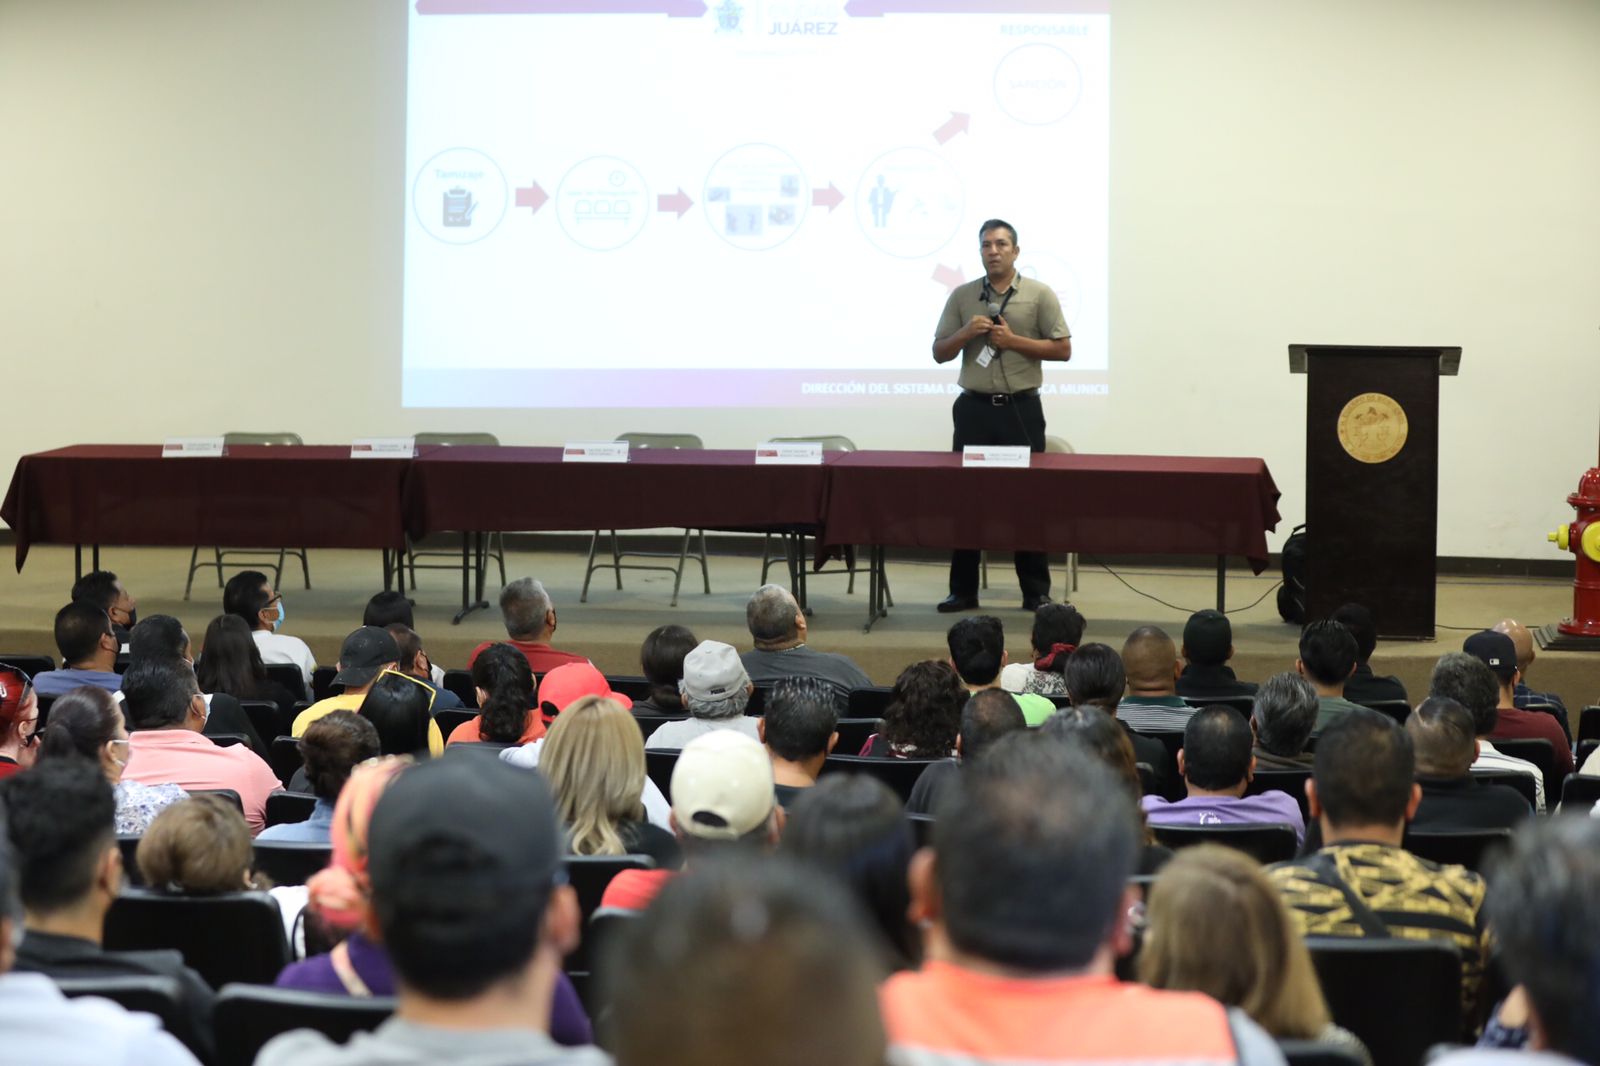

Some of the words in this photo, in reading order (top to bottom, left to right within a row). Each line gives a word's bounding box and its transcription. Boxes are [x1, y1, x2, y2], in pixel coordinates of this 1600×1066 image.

[768, 18, 838, 35] JUÁREZ
[801, 380, 865, 394] DIRECCIÓN
[868, 383, 890, 394] DEL
[893, 383, 944, 394] SISTEMA
